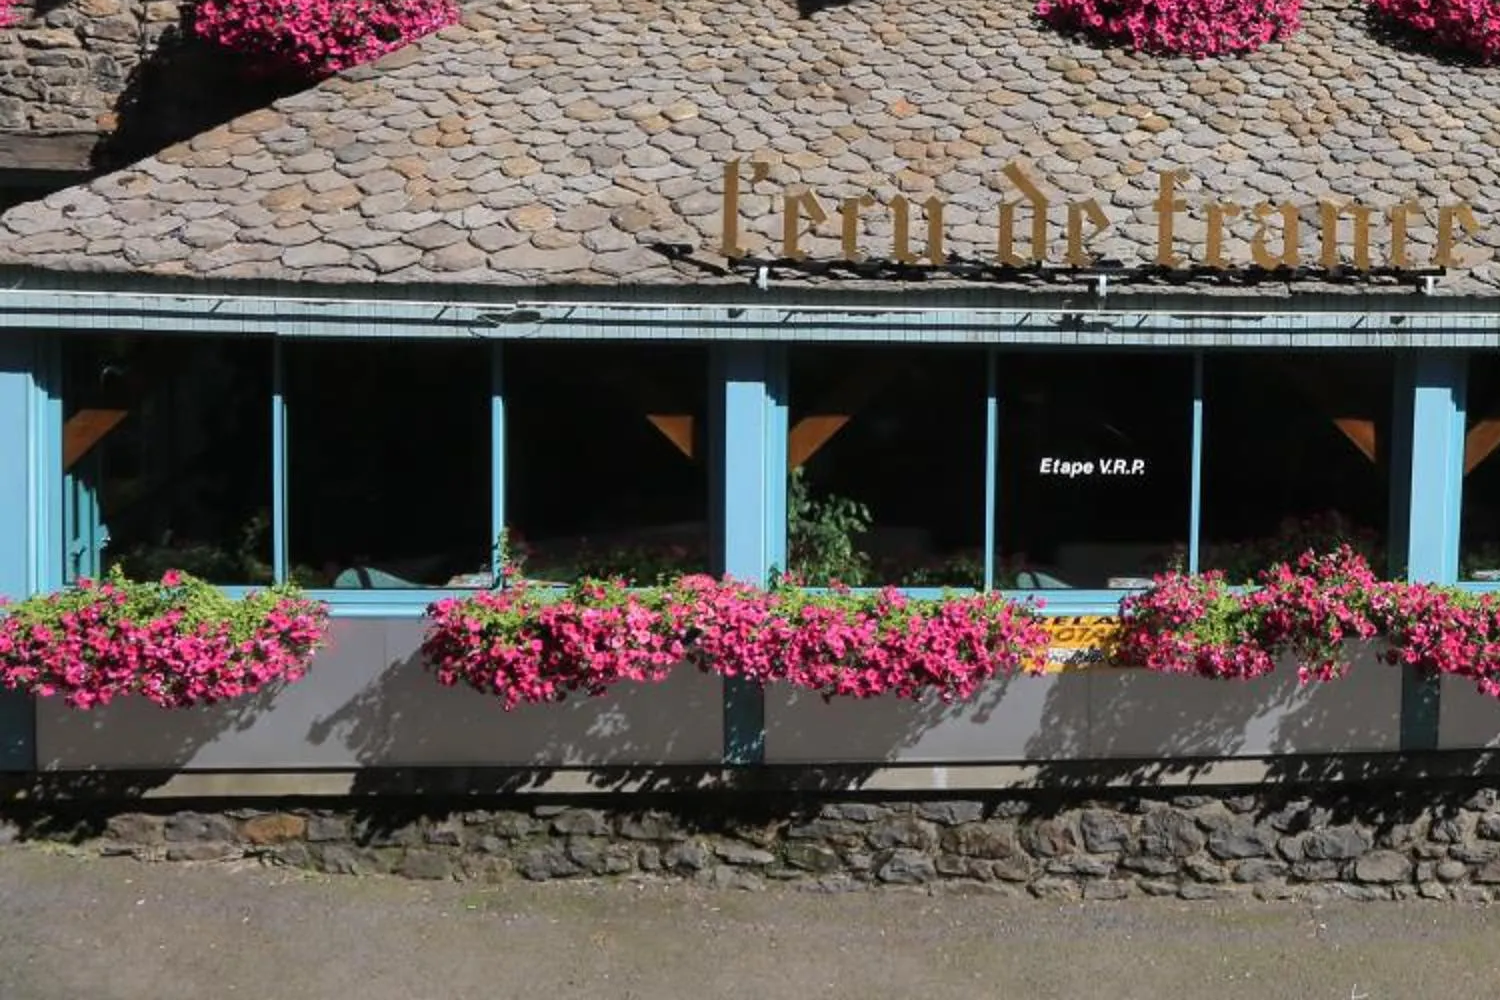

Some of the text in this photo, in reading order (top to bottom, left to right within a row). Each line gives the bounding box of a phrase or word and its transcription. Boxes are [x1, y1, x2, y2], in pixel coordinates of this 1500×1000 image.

[994, 160, 1111, 268] de
[1151, 167, 1481, 271] france
[1039, 456, 1145, 479] Etape V.R.P.
